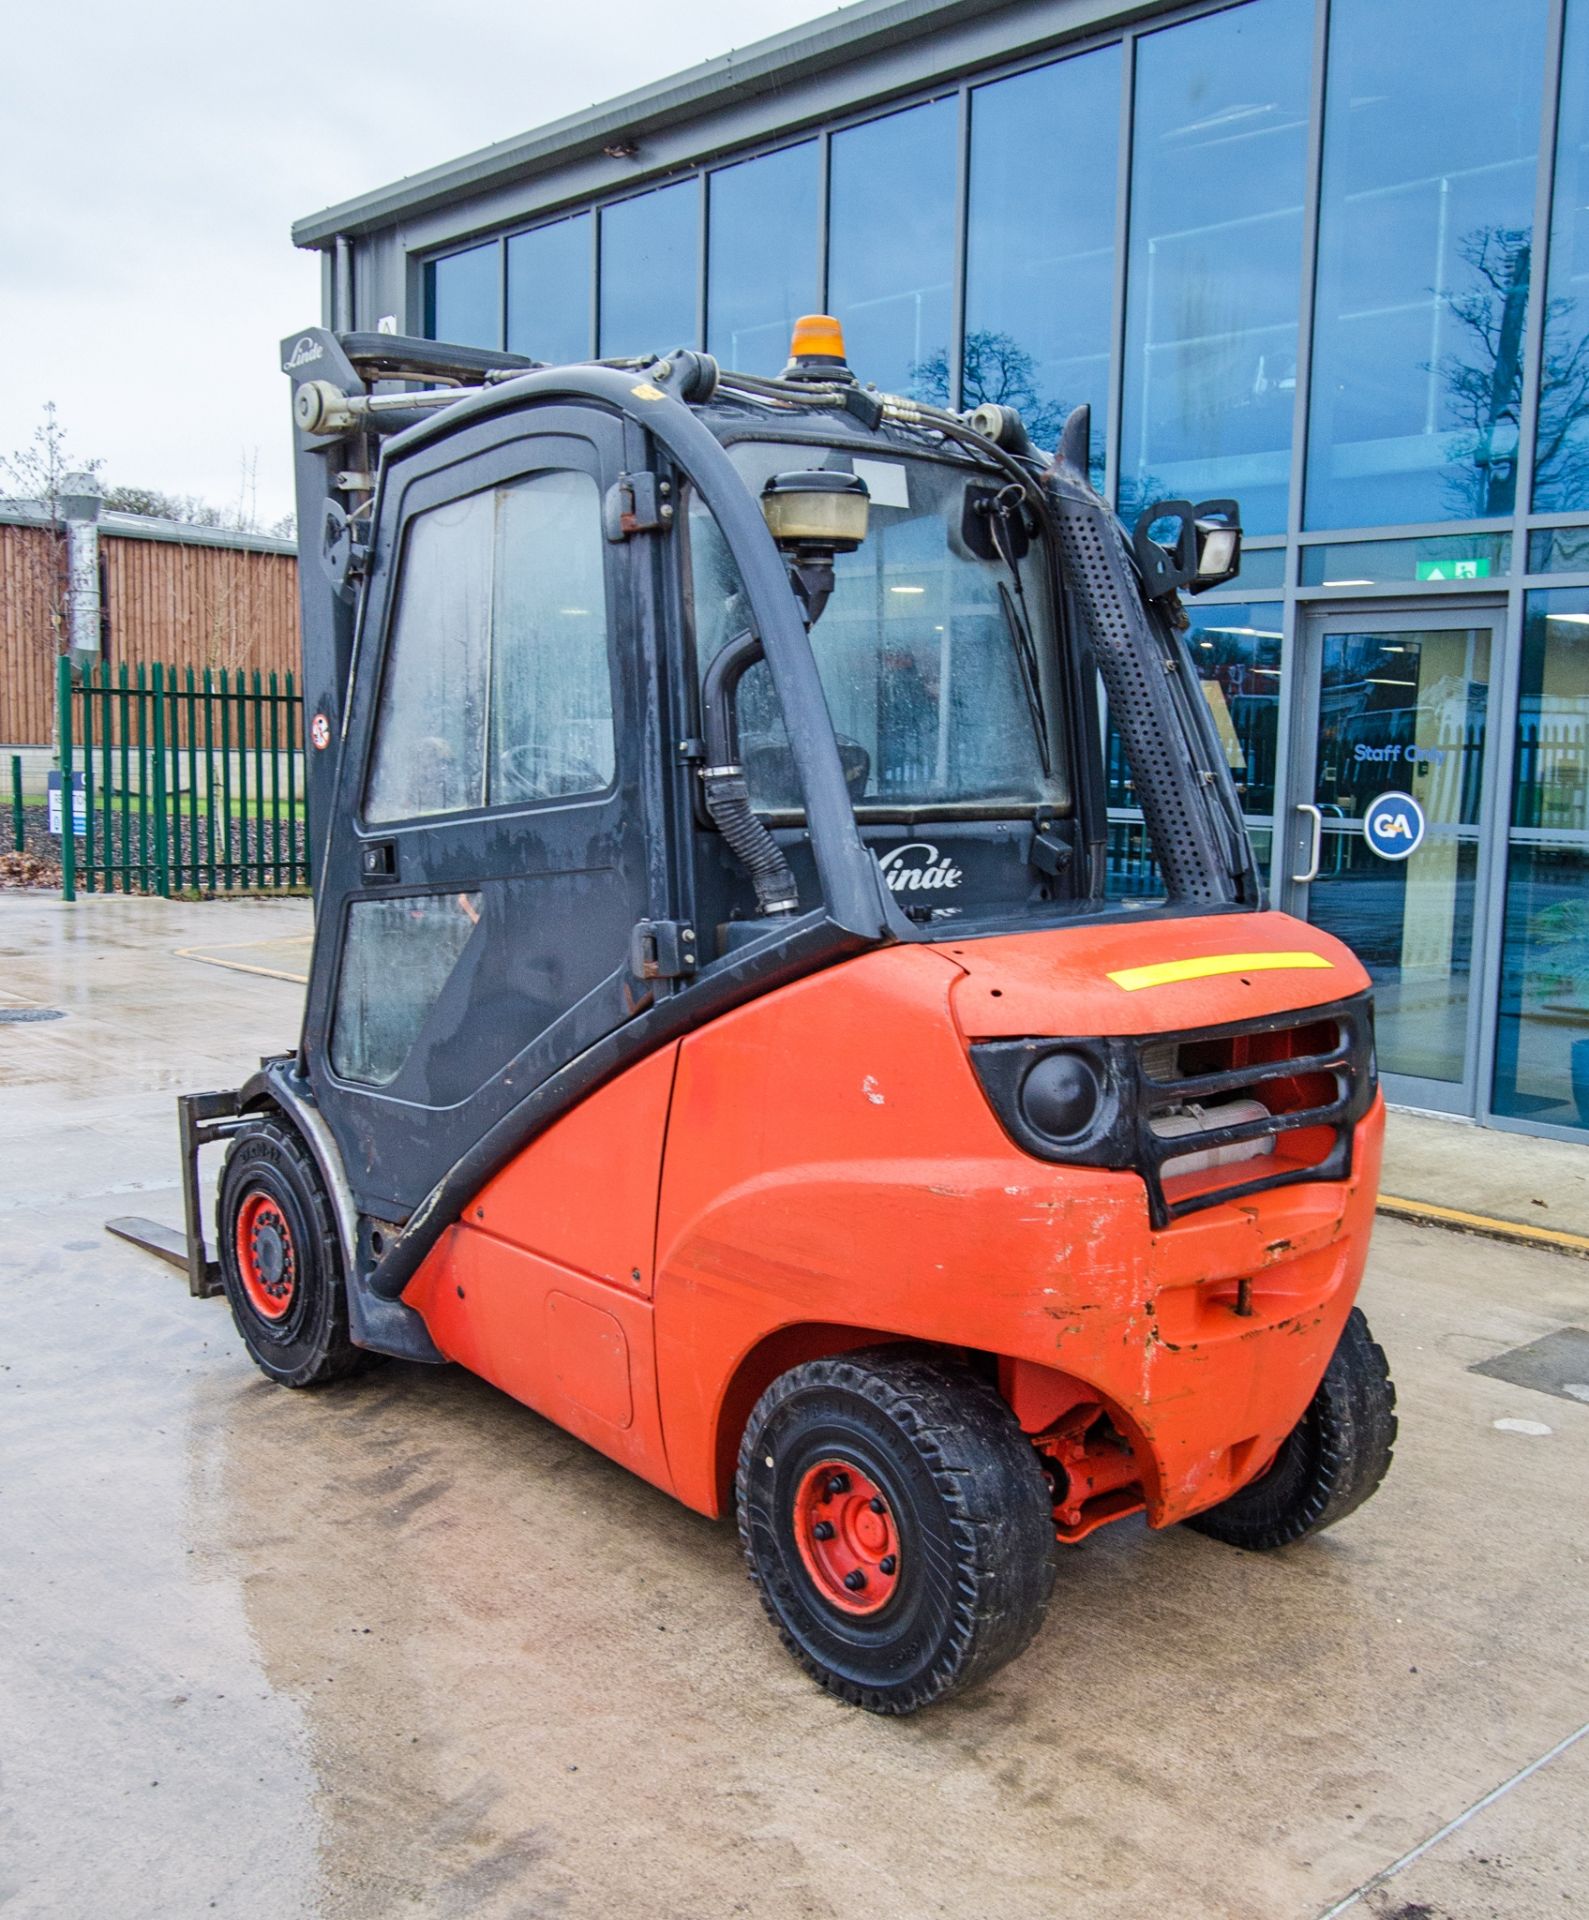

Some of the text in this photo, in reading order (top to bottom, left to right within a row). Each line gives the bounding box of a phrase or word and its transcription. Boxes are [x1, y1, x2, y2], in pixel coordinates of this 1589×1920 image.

[283, 337, 323, 370] Linde
[1354, 744, 1401, 761] Staff
[1373, 813, 1413, 839] GA
